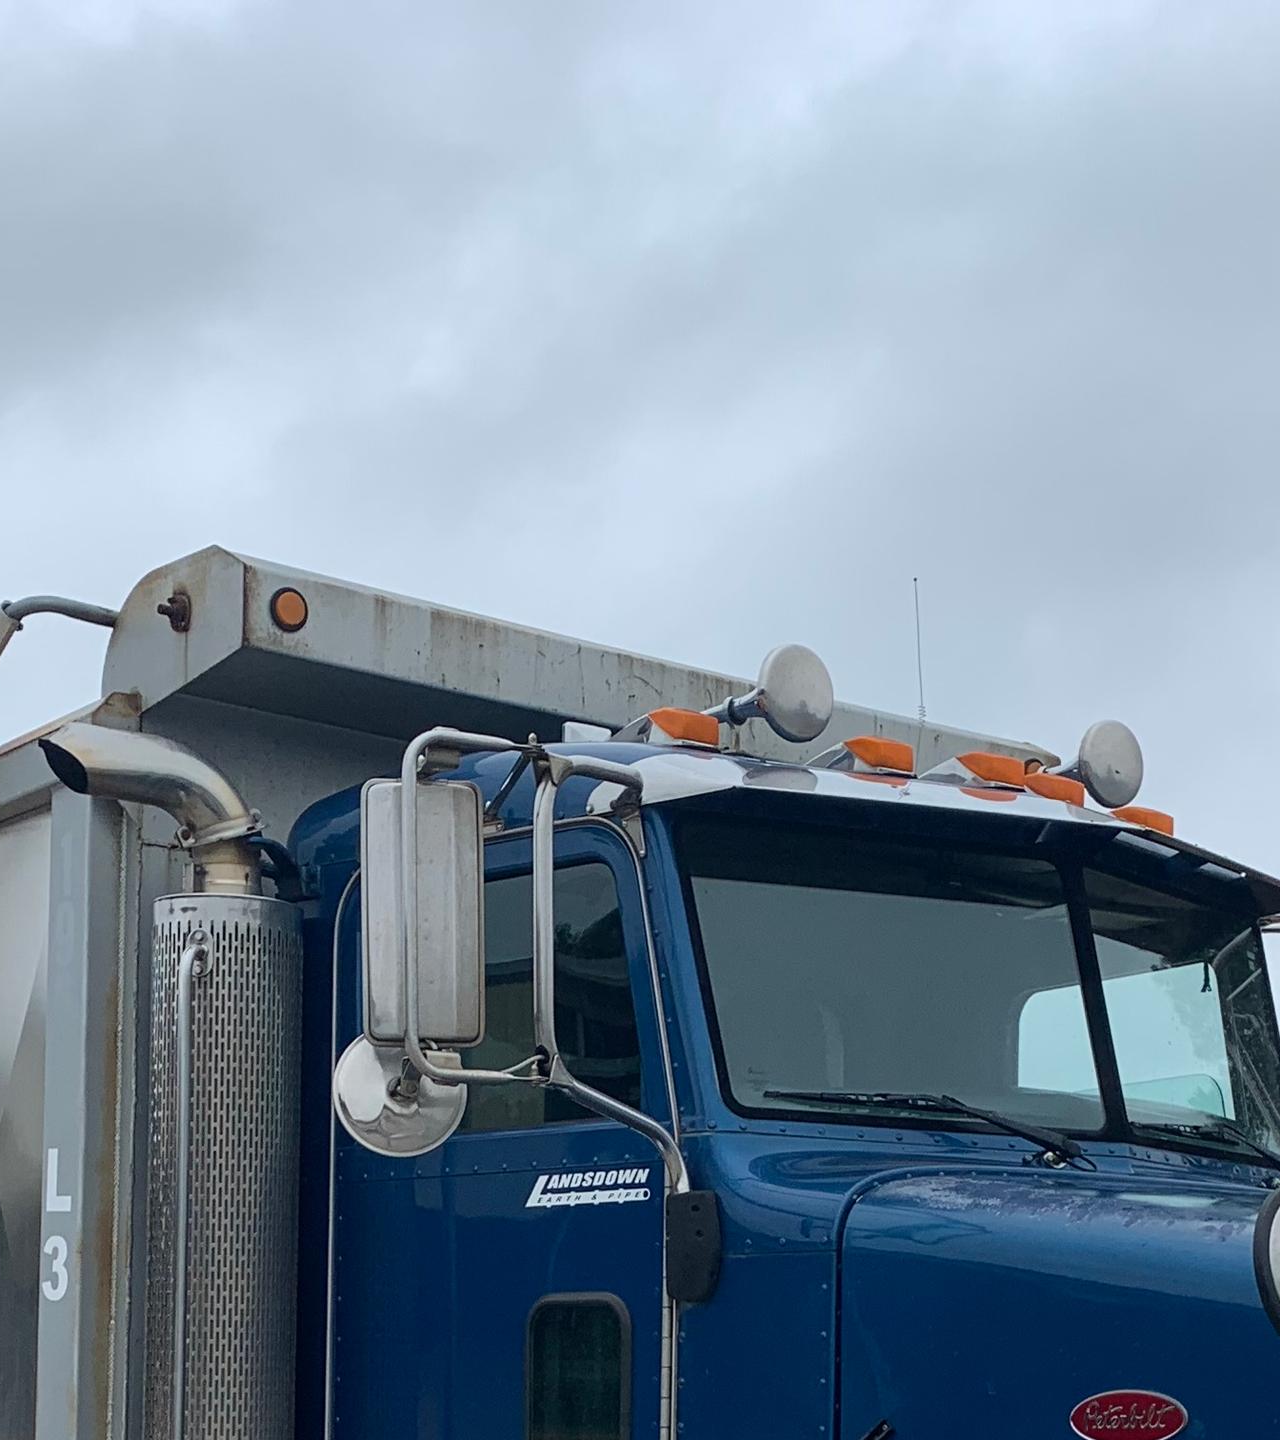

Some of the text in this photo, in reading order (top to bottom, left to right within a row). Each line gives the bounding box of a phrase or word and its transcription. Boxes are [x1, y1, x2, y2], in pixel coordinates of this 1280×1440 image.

[524, 1168, 650, 1208] LANDSDOWN
[537, 1191, 642, 1204] EARTH & PIPE
[42, 1148, 72, 1301] L 3
[1083, 1401, 1176, 1433] Peterbilt
